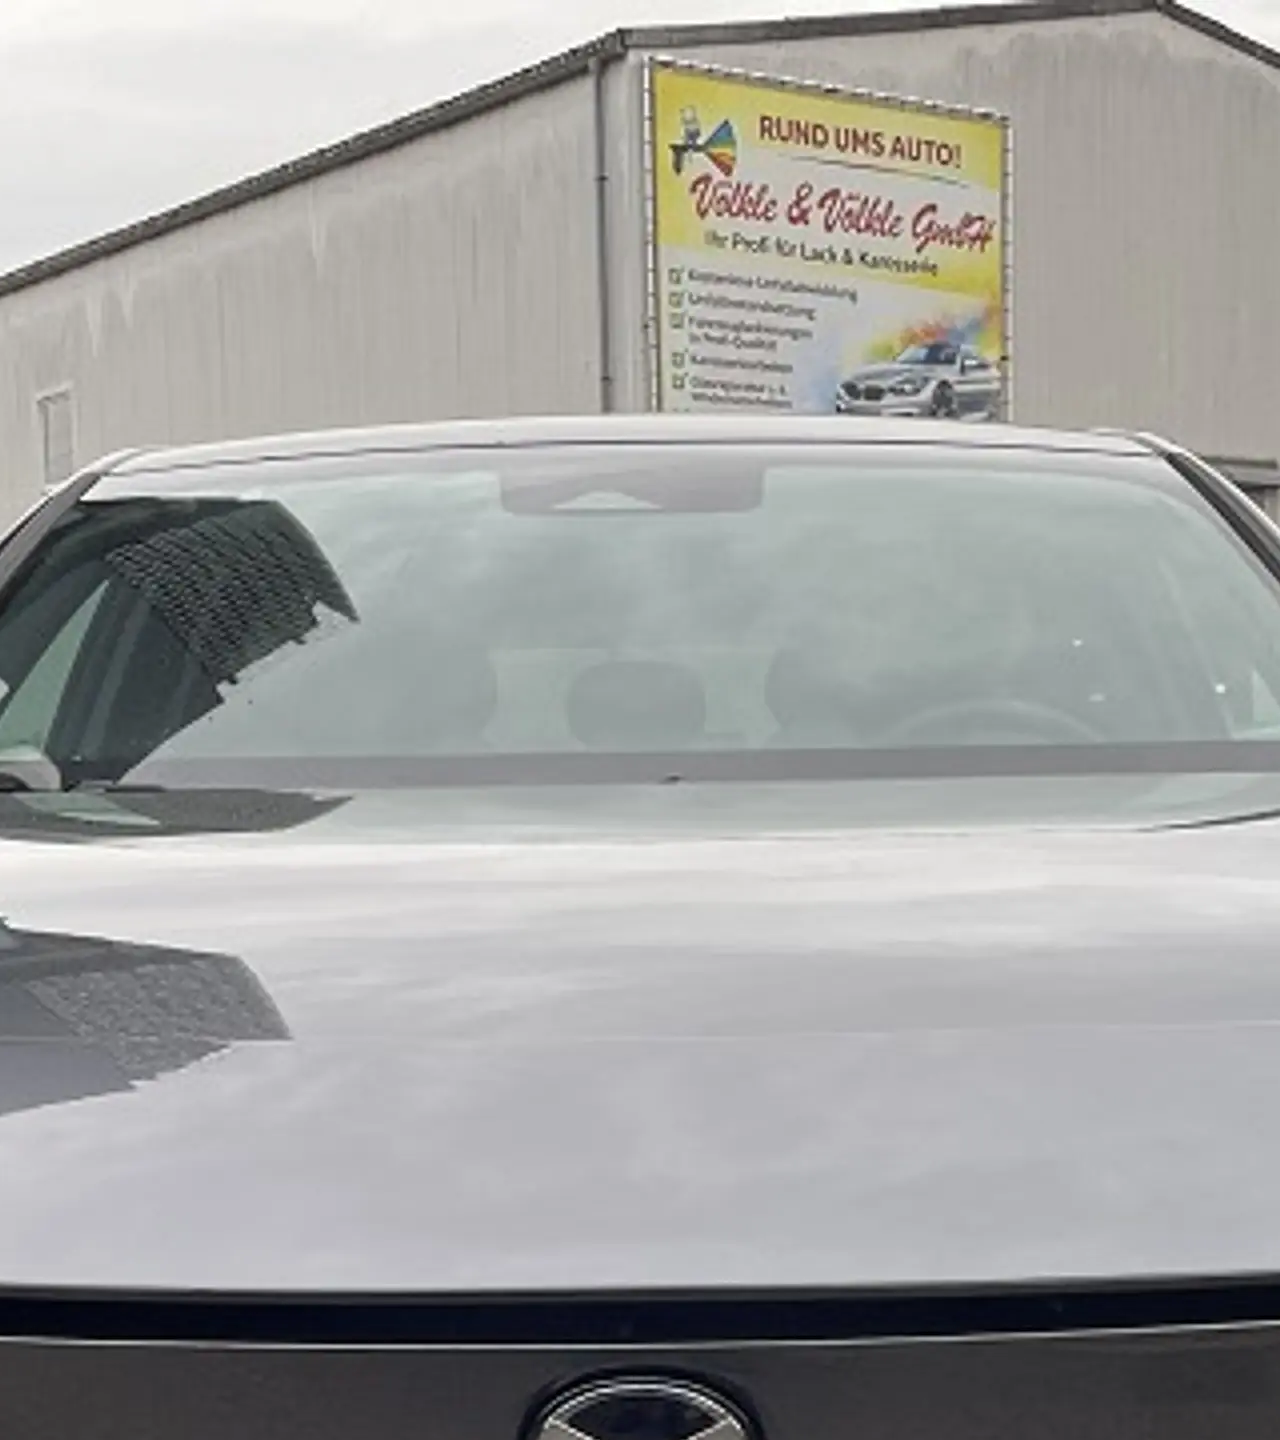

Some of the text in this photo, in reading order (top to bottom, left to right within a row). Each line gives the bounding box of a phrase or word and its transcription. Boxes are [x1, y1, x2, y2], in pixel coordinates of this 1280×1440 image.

[759, 115, 962, 168] RUND UMS AUTO!
[787, 181, 814, 226] &
[910, 202, 997, 253] GmbH
[732, 231, 769, 253] Profi
[775, 235, 797, 257] für
[800, 241, 837, 264] Lack
[840, 247, 853, 265] &
